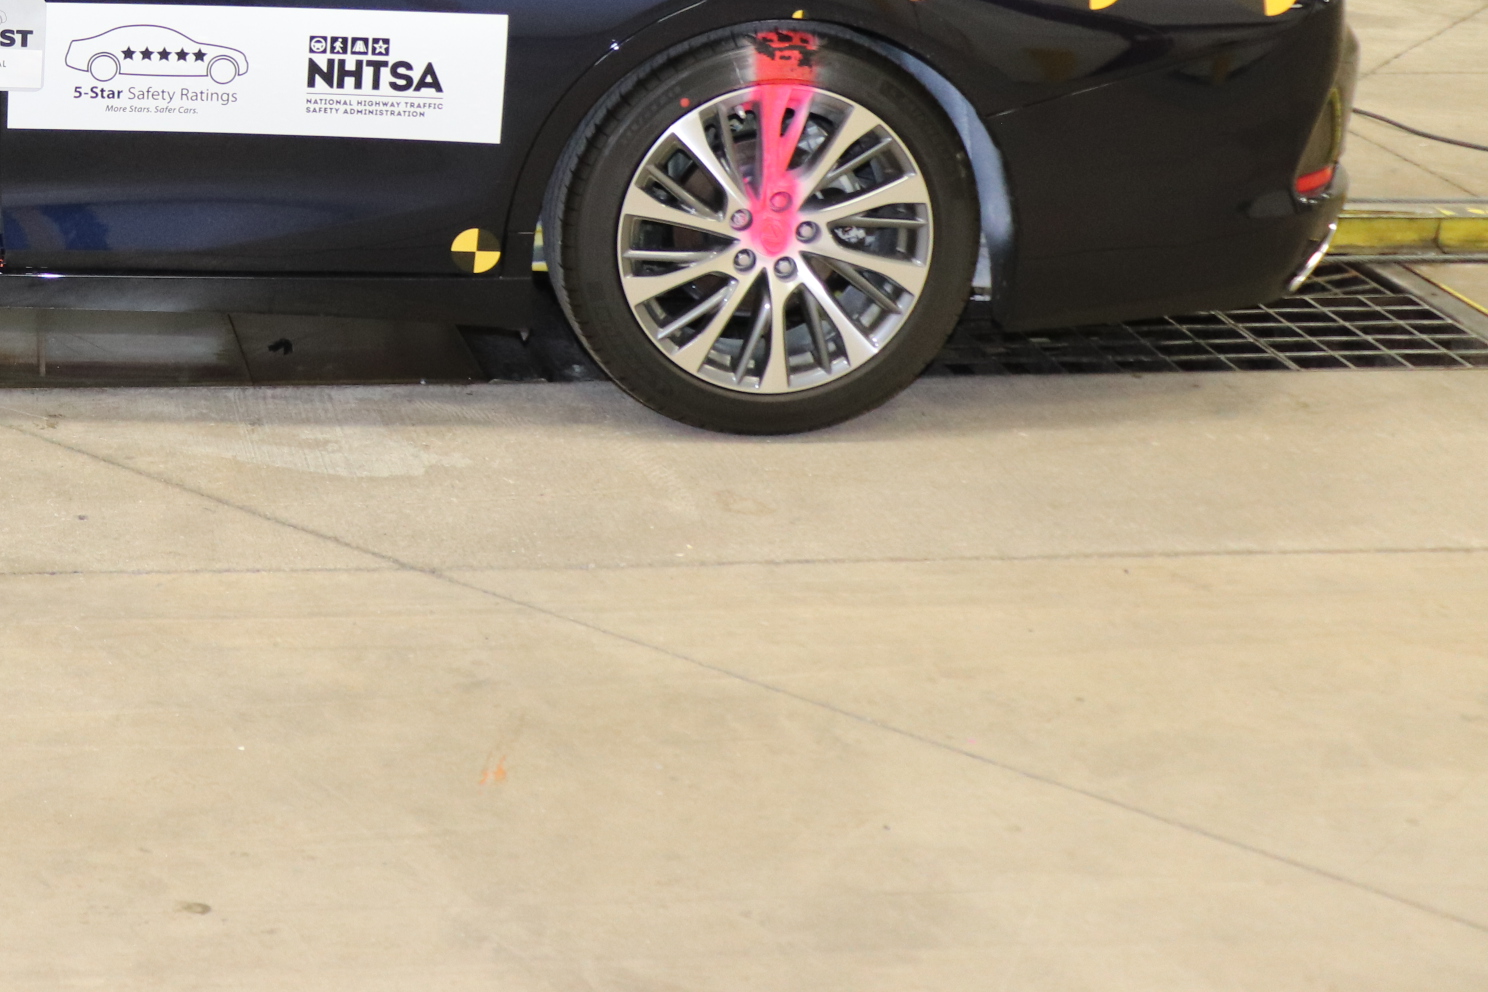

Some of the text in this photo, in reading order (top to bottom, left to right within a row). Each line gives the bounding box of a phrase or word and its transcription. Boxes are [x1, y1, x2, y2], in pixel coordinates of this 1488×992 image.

[306, 57, 444, 93] NHTSA
[73, 86, 238, 106] 5-Star Safety Ratings
[105, 105, 199, 114] More Stars. Safer Cars.
[306, 98, 444, 110] NATIONAL HIGHWAY TRAFFIC
[306, 107, 425, 118] SAFETY ADMINISTRATION
